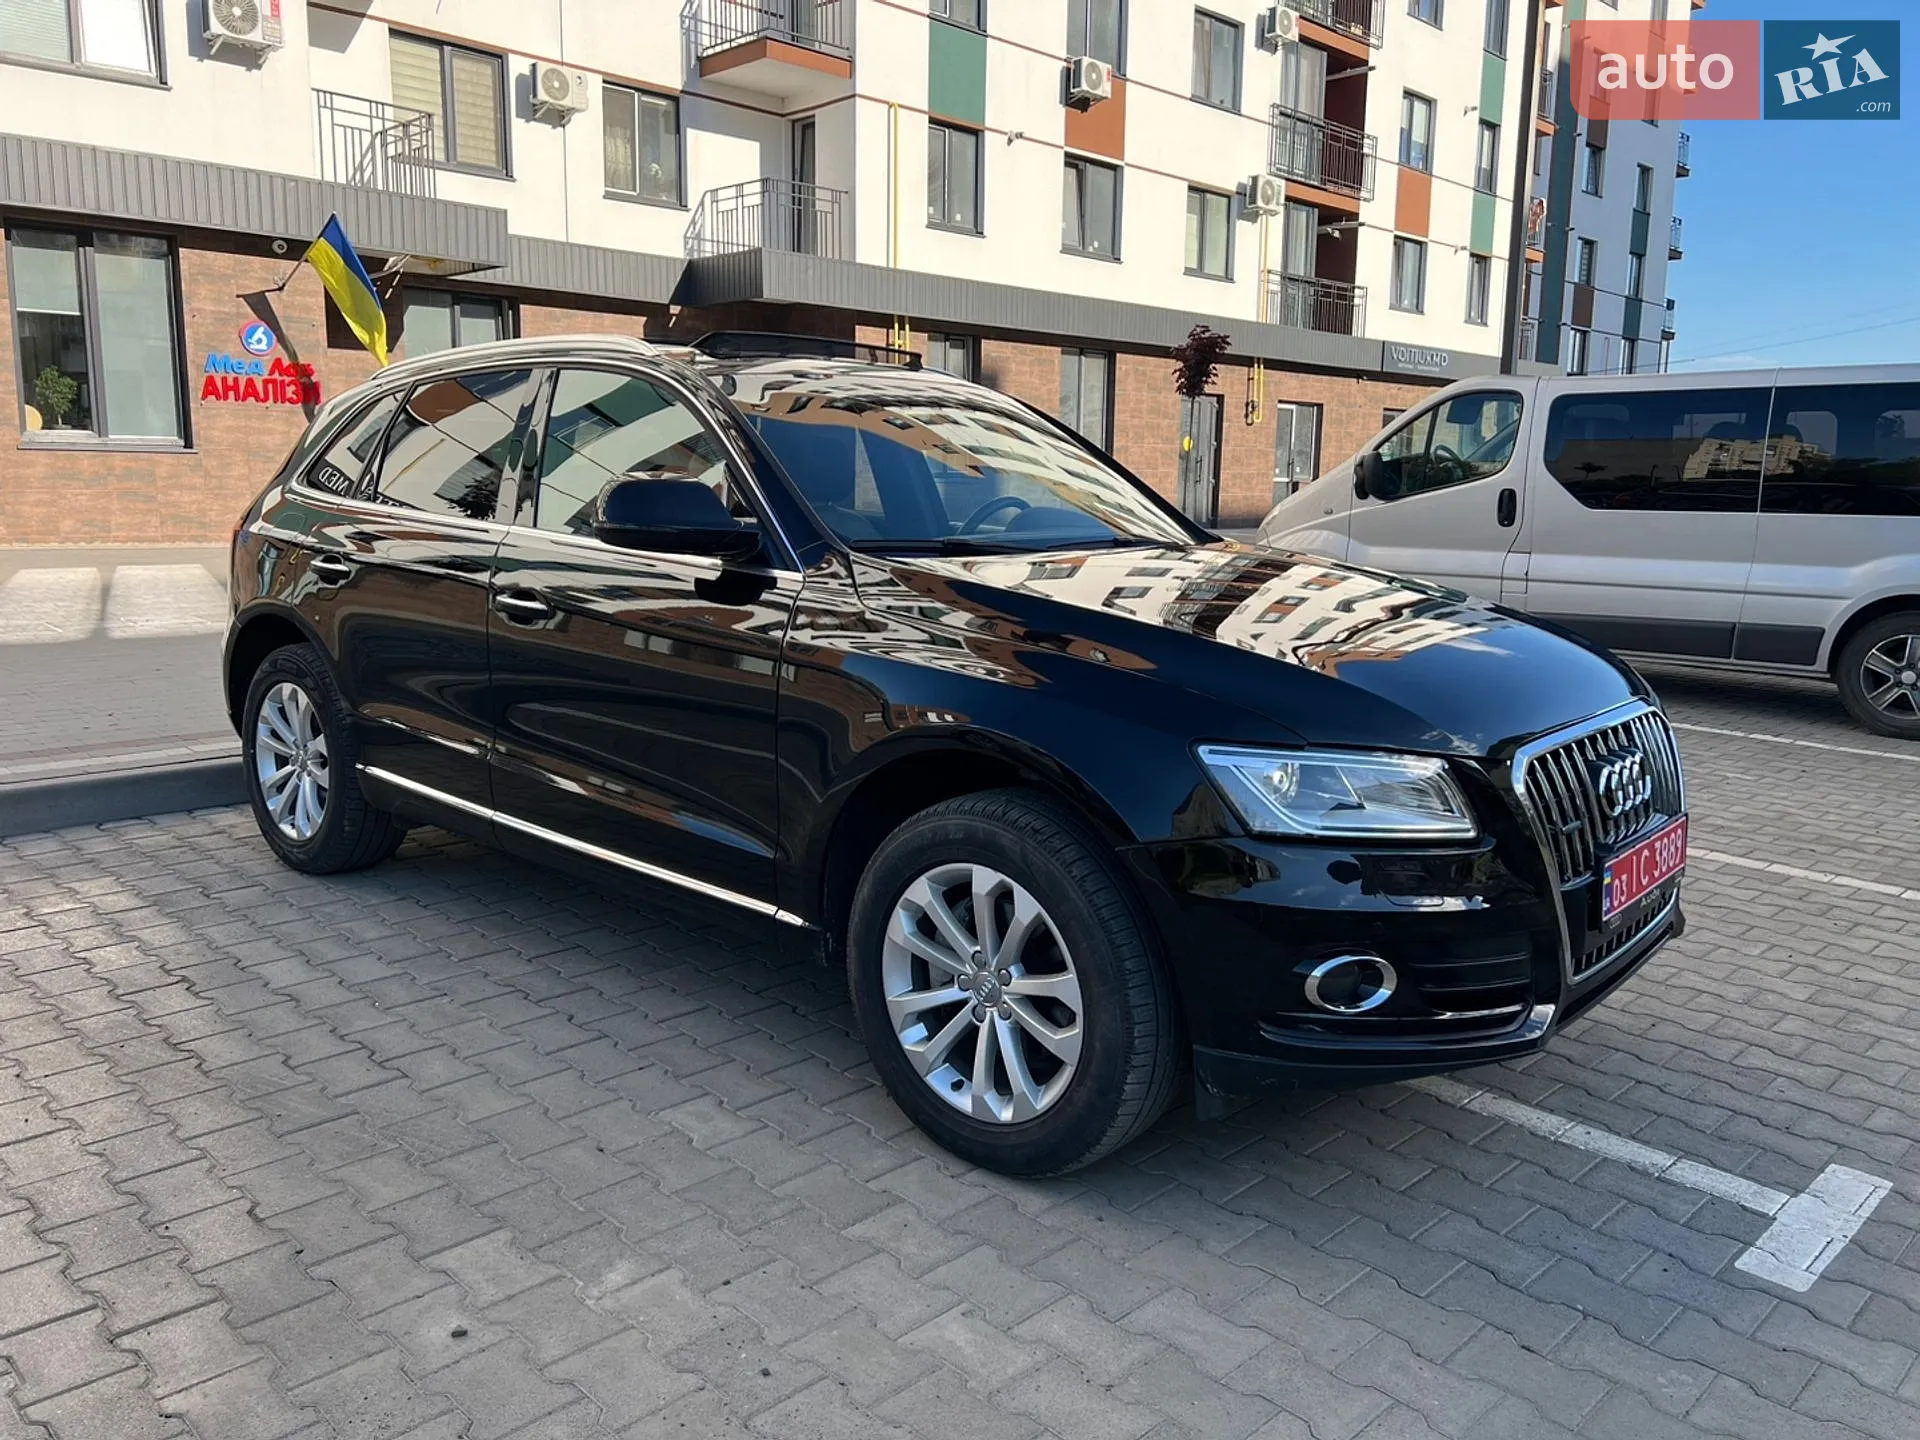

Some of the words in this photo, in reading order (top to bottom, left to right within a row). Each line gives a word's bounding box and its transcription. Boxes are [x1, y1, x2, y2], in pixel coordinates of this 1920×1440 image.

[204, 353, 265, 376] Мед
[202, 375, 321, 404] АНАЛІЗИ
[1613, 873, 1627, 907] 03
[1653, 828, 1683, 879] 3889
